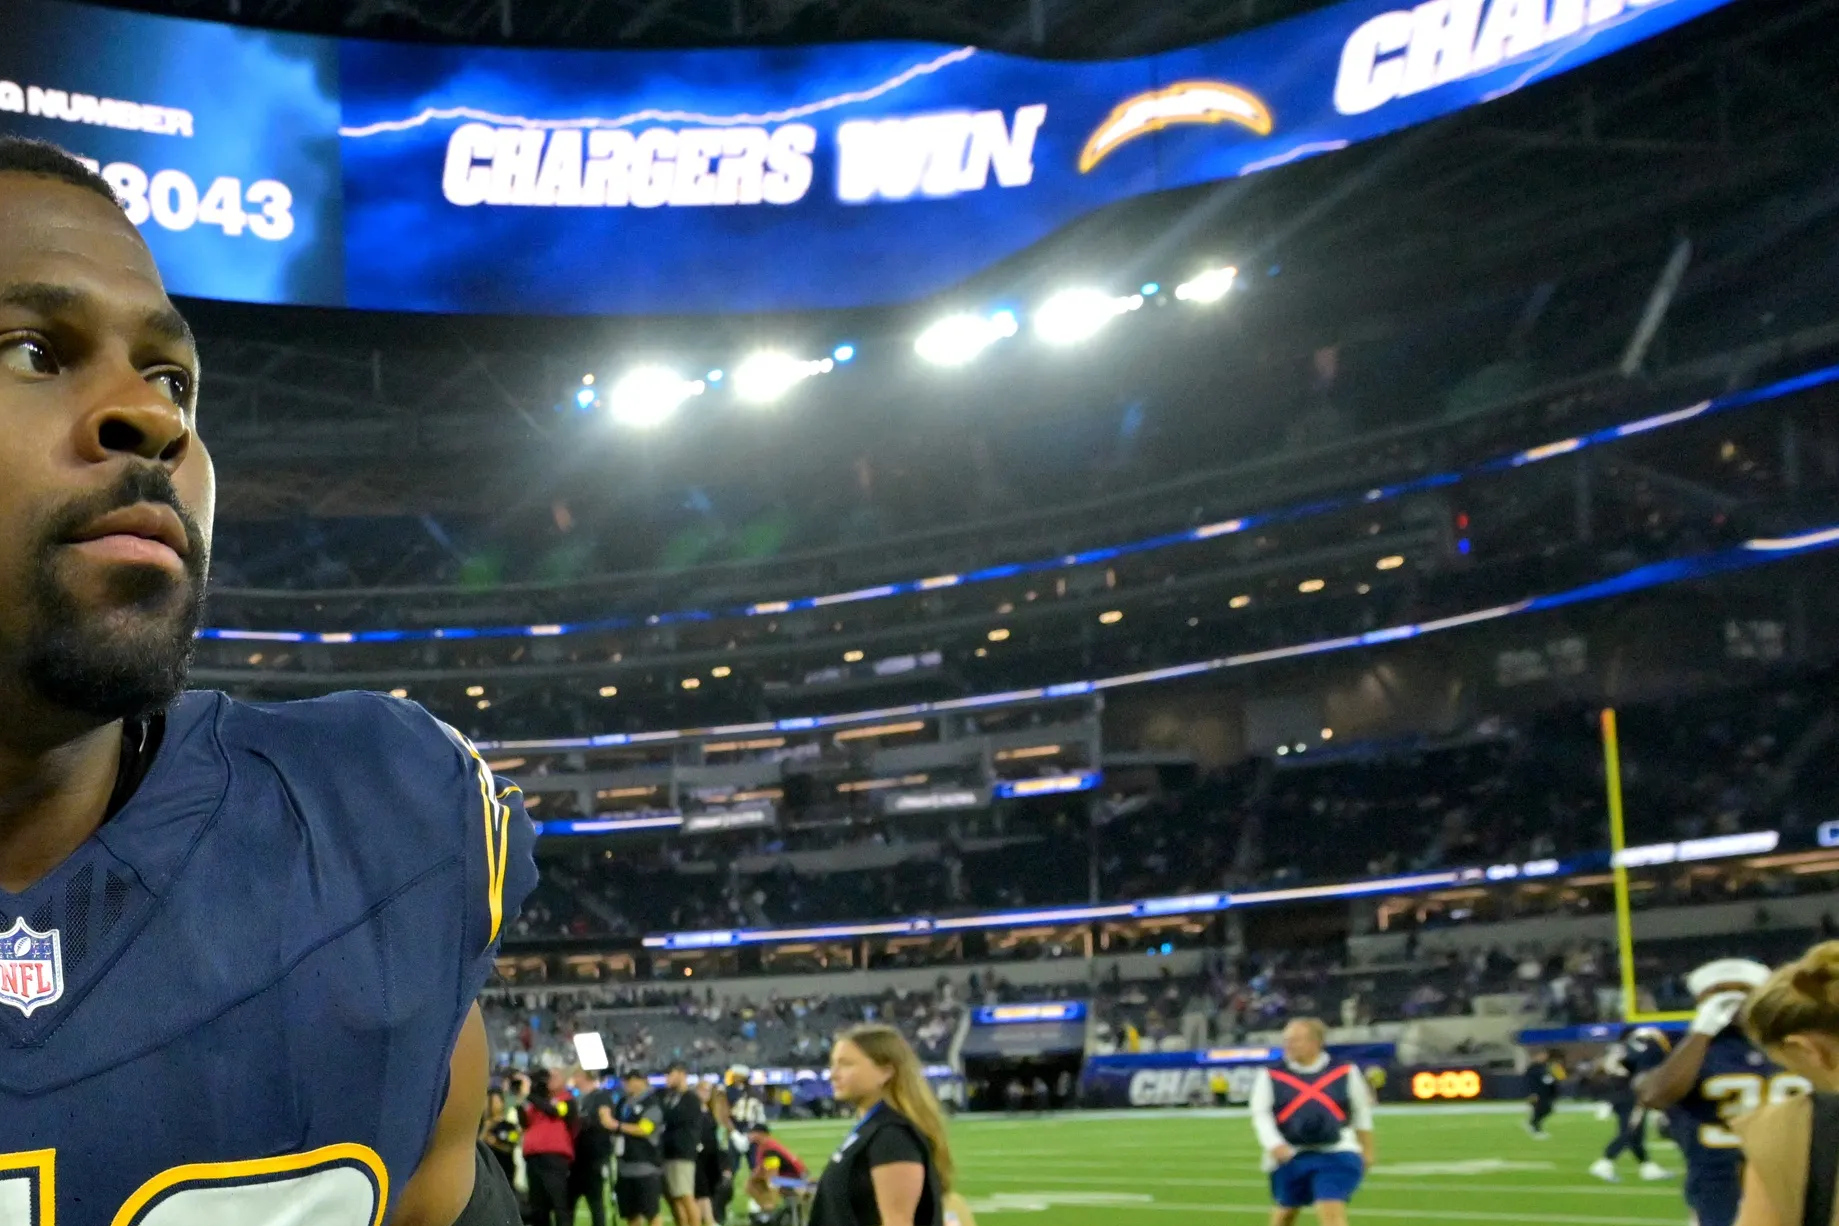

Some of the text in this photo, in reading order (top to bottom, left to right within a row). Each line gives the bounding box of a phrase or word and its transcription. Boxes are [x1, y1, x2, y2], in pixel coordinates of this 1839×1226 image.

[26, 85, 194, 138] NUMBER
[443, 104, 1047, 207] CHARGERS WIN
[0, 962, 52, 998] NFL
